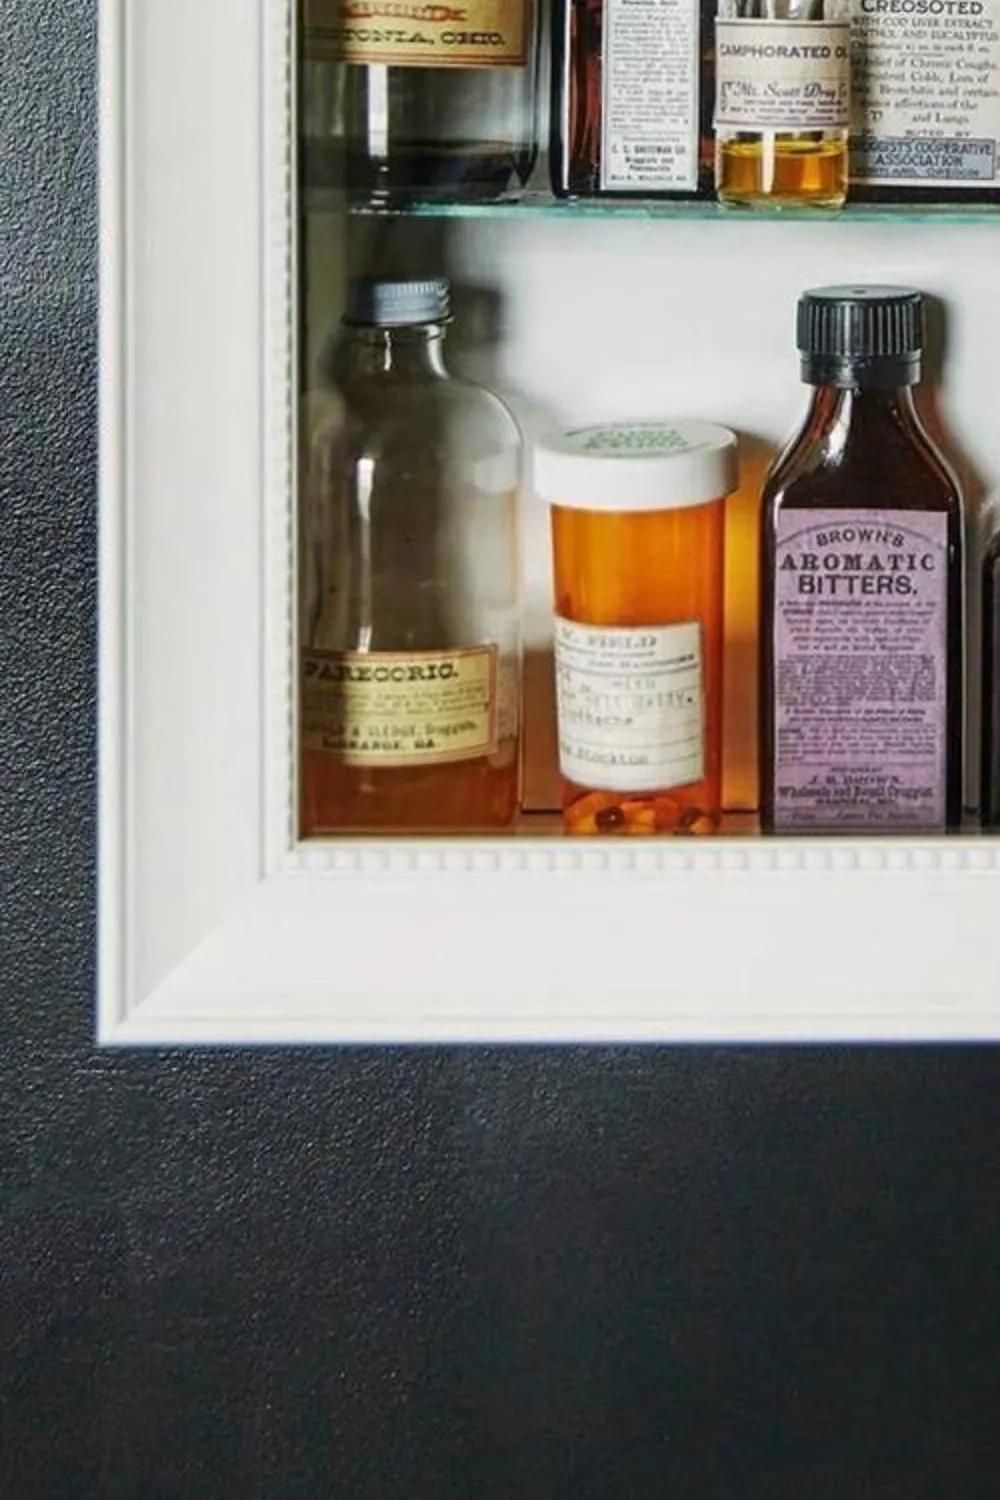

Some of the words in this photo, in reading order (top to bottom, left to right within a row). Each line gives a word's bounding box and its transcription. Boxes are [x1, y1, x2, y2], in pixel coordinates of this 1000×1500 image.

[815, 527, 905, 548] BROWN'S
[778, 552, 936, 572] AROMATIC
[797, 573, 919, 597] BITTERS.
